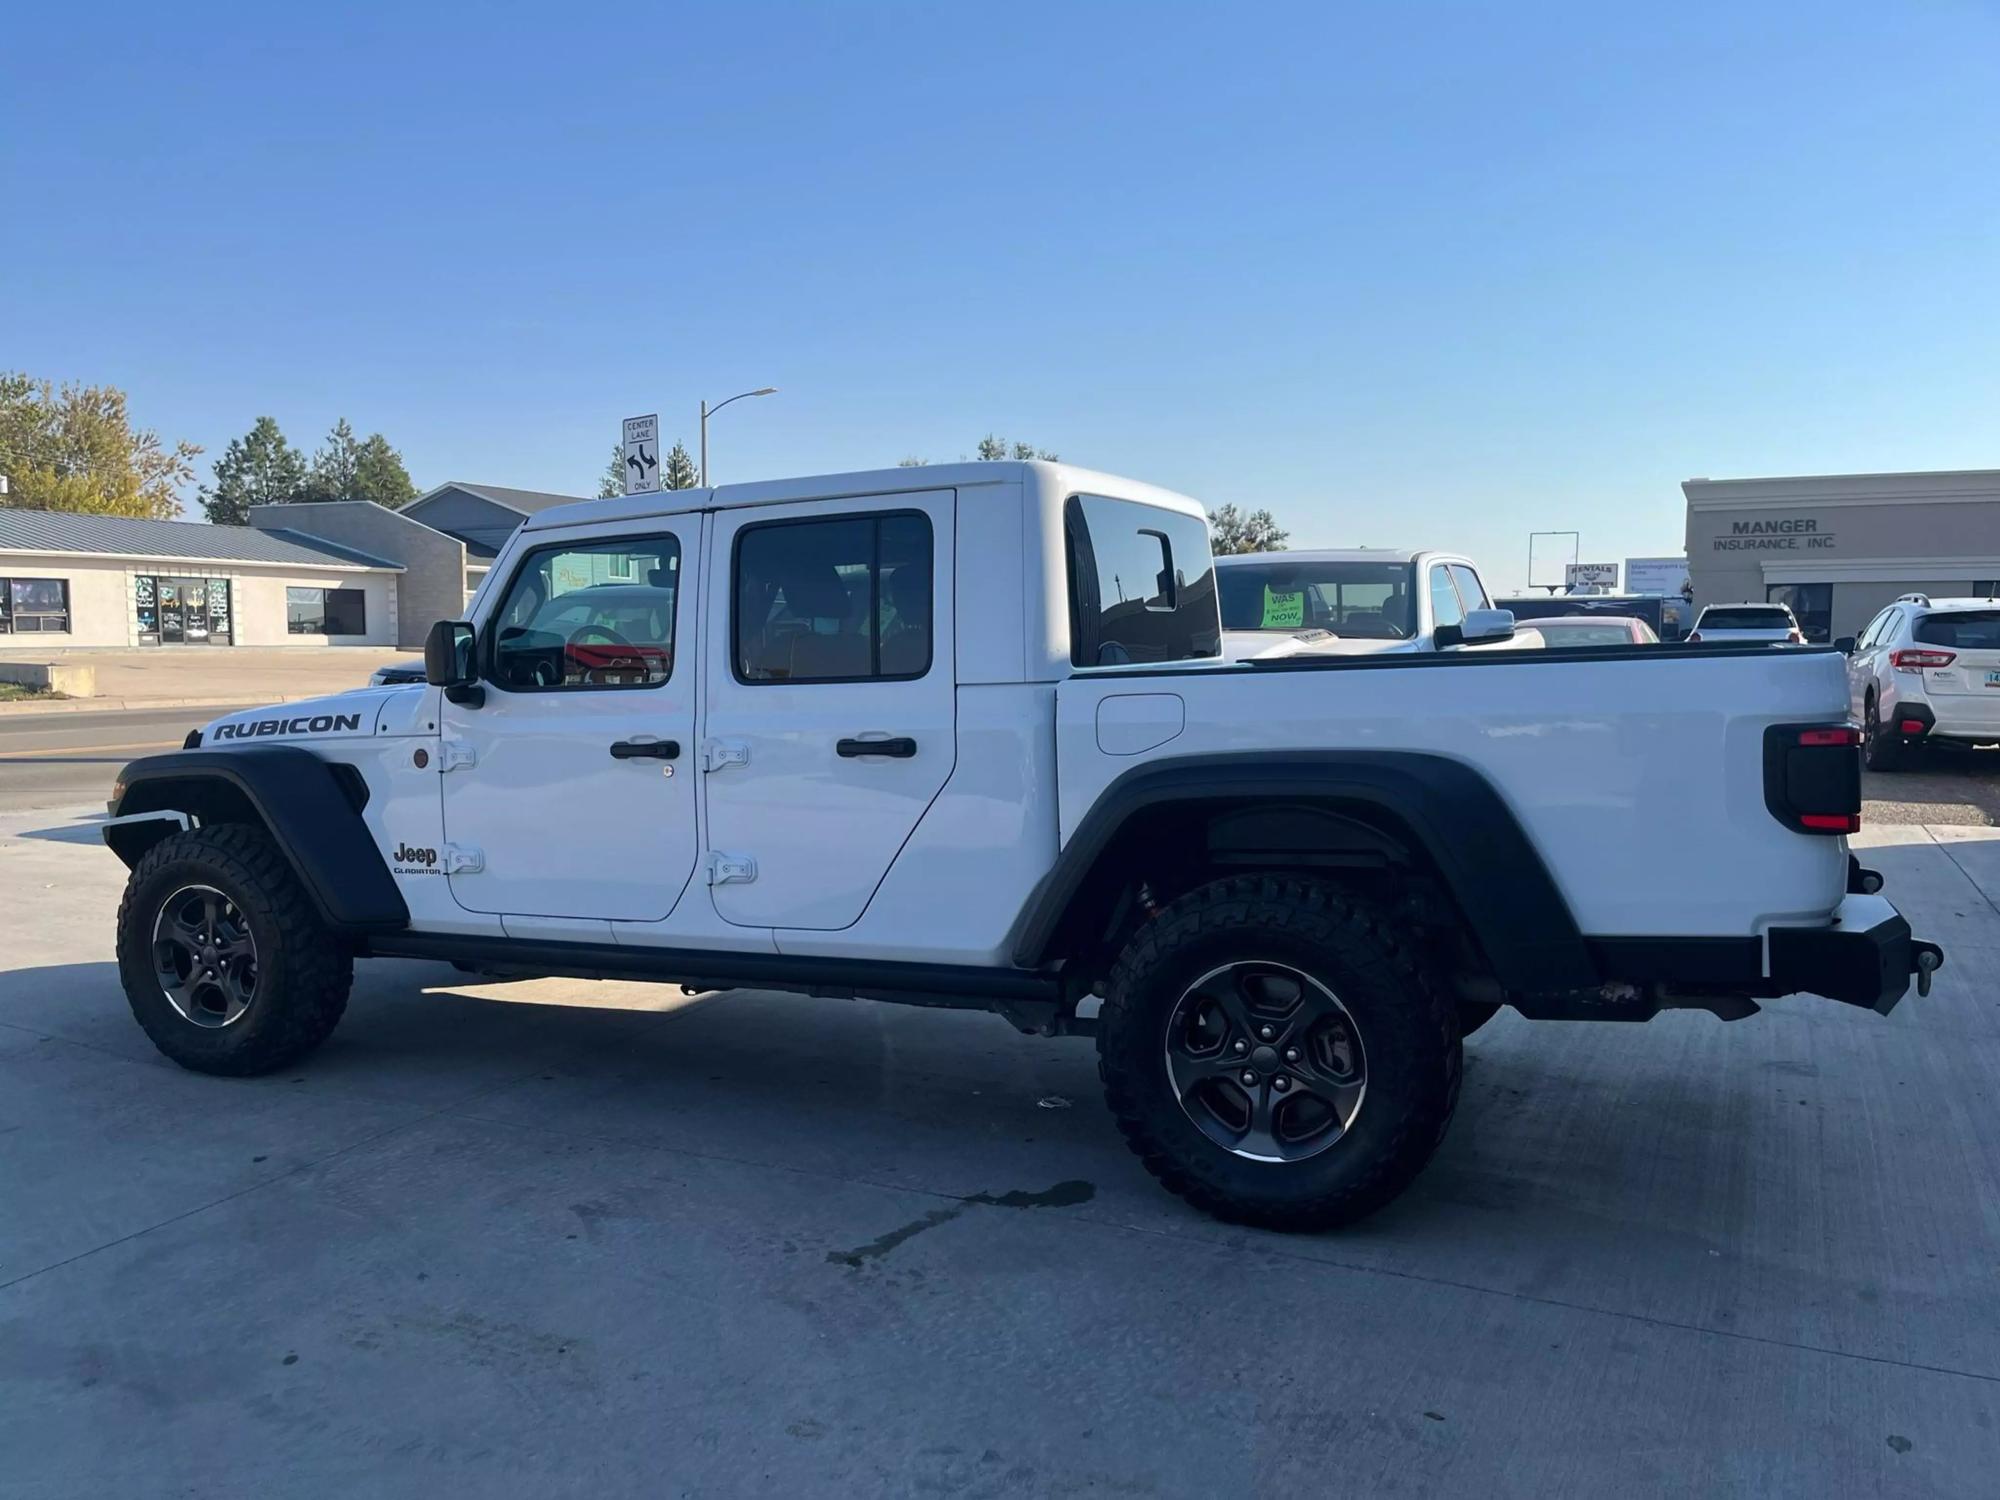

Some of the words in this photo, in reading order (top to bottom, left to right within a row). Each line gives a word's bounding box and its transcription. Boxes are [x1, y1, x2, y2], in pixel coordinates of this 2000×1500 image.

[627, 419, 654, 431] CENTER
[631, 429, 650, 440] LANE
[634, 481, 651, 490] ONLY
[1732, 519, 1817, 535] MANGER
[1571, 565, 1612, 574] RENTALS
[1271, 593, 1295, 604] WAS
[1270, 611, 1298, 622] NOW
[213, 713, 361, 740] RUBICON
[393, 842, 437, 867] Jeep
[393, 867, 440, 875] GLADIATOR
